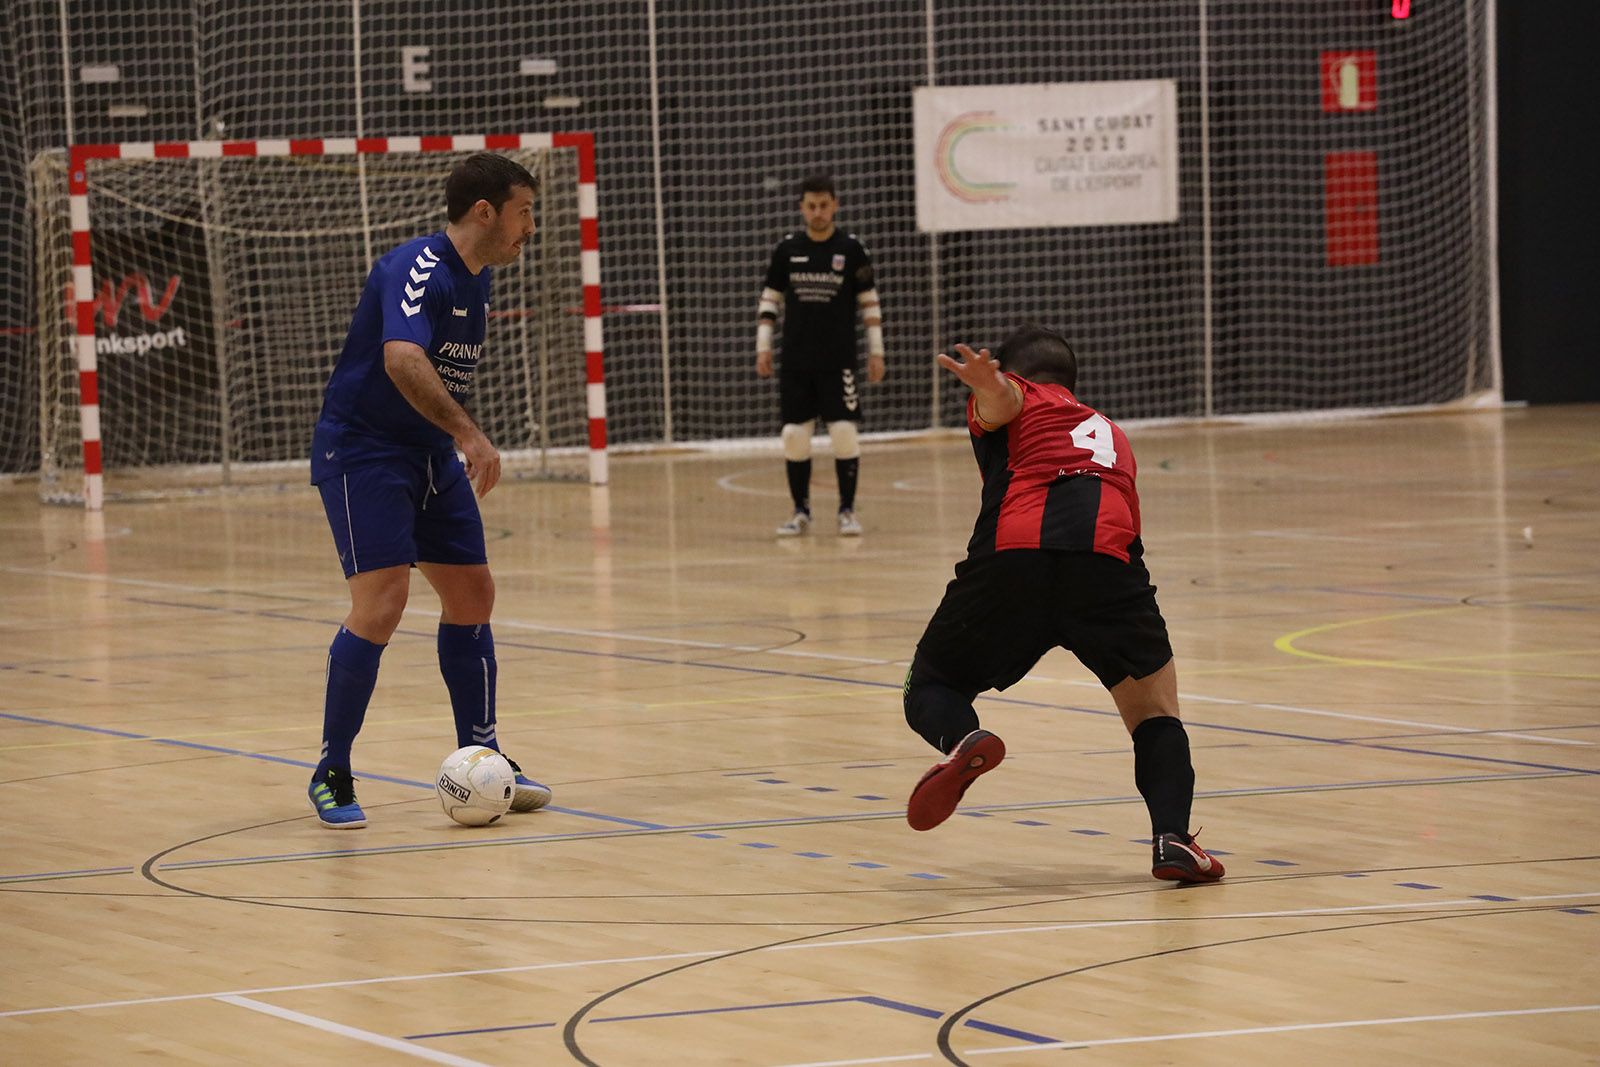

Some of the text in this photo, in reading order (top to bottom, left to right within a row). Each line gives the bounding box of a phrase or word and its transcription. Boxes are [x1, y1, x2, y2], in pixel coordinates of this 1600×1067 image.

[402, 46, 432, 92] E
[1068, 412, 1117, 469] 4
[439, 775, 471, 802] MUNICH
